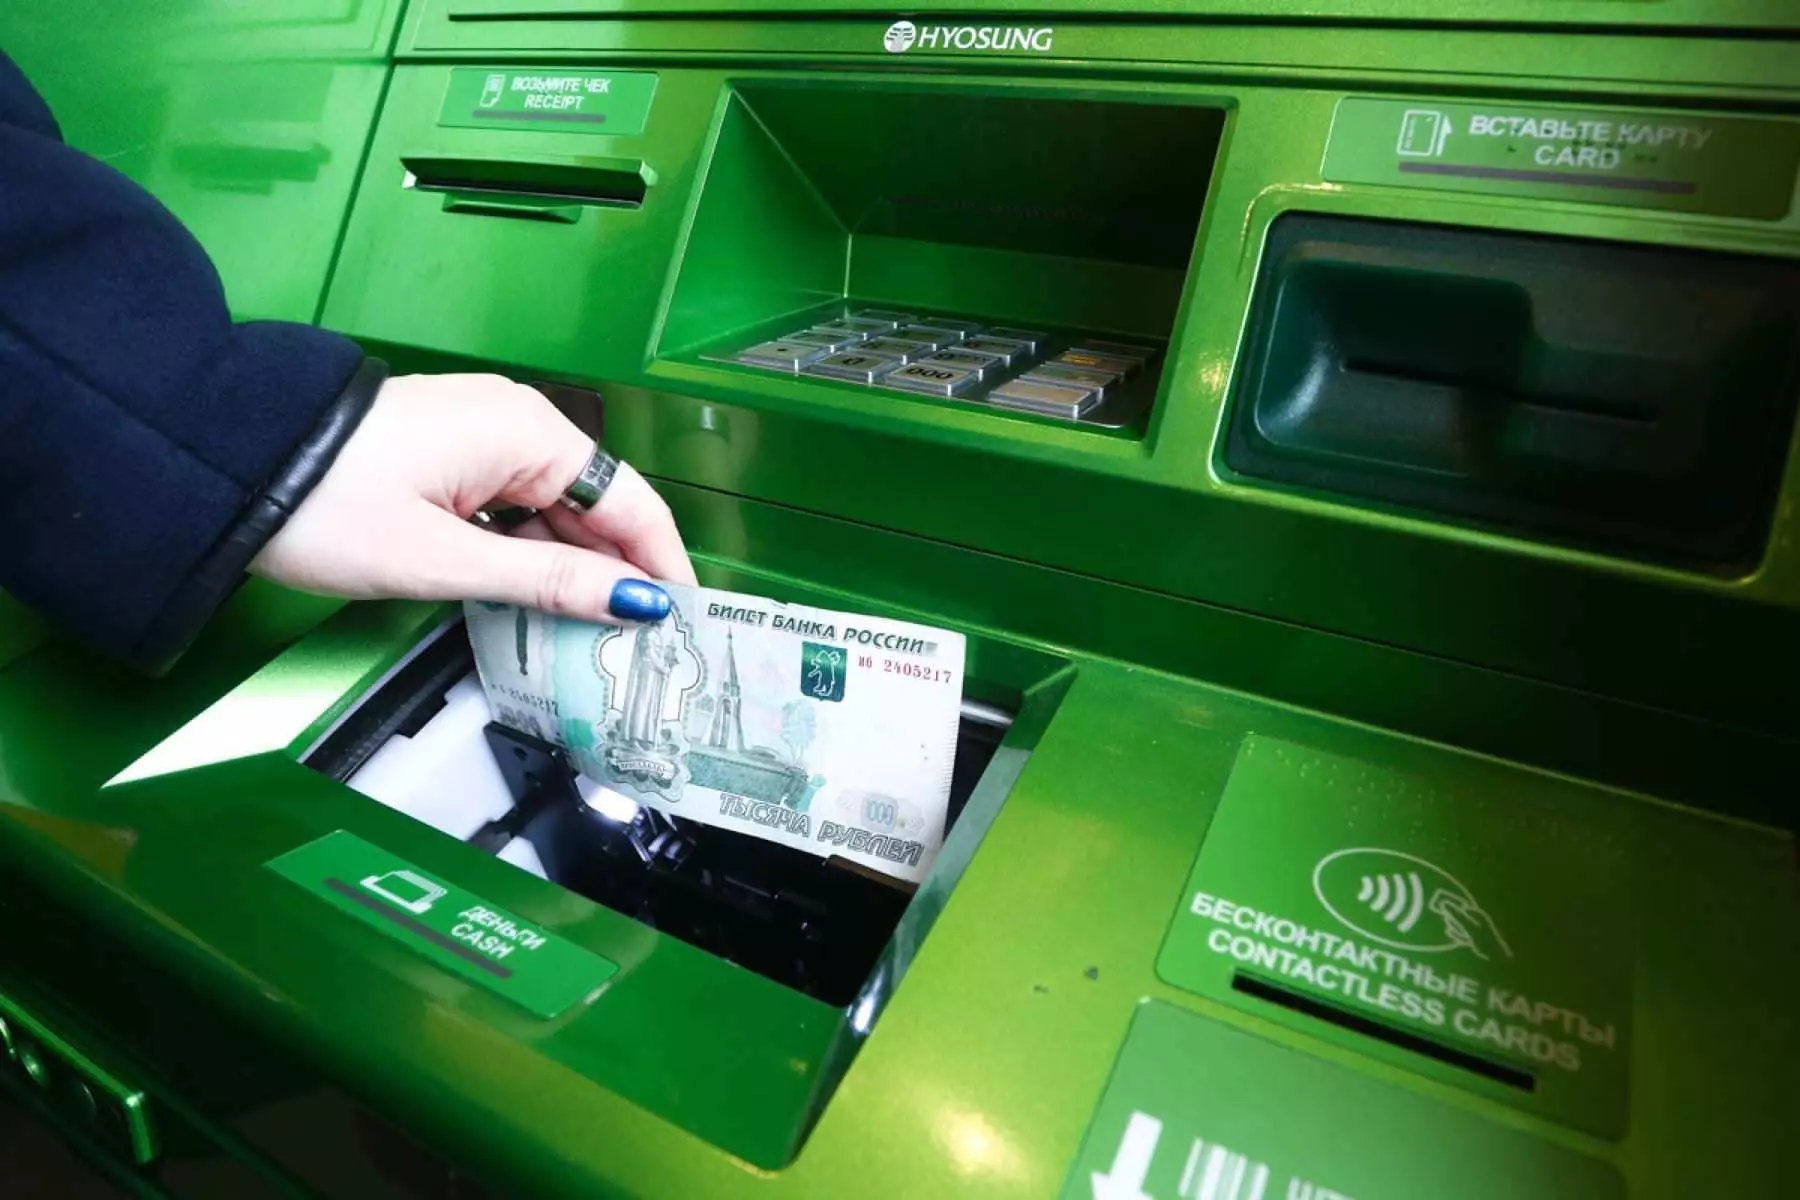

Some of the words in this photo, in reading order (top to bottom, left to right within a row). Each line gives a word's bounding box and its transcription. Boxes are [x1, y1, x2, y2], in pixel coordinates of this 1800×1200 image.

[917, 26, 1053, 51] HYOSUNG
[524, 94, 584, 109] RECEIPT
[584, 78, 611, 92] ЧЕК
[1469, 115, 1611, 142] ВСТАВЬТЕ
[1617, 122, 1713, 150] КАРТУ
[1534, 144, 1621, 169] CARD
[707, 602, 768, 626] БИЛЕТ
[772, 614, 837, 640] БАНКА
[843, 628, 926, 654] РОССИИ
[883, 659, 952, 684] 2405217
[719, 792, 810, 837] ТЫСЯЧА
[816, 820, 925, 867] РУБЛЕЙ
[450, 923, 515, 959] CASH
[457, 905, 547, 950] ДЕНЬГИ
[1190, 891, 1478, 1001] БЕСКОНТАКТНЫЕ
[1488, 987, 1617, 1049] КАРТЫ
[1207, 929, 1446, 1026] CONTACTLESS
[1453, 1010, 1581, 1073] CARDS
